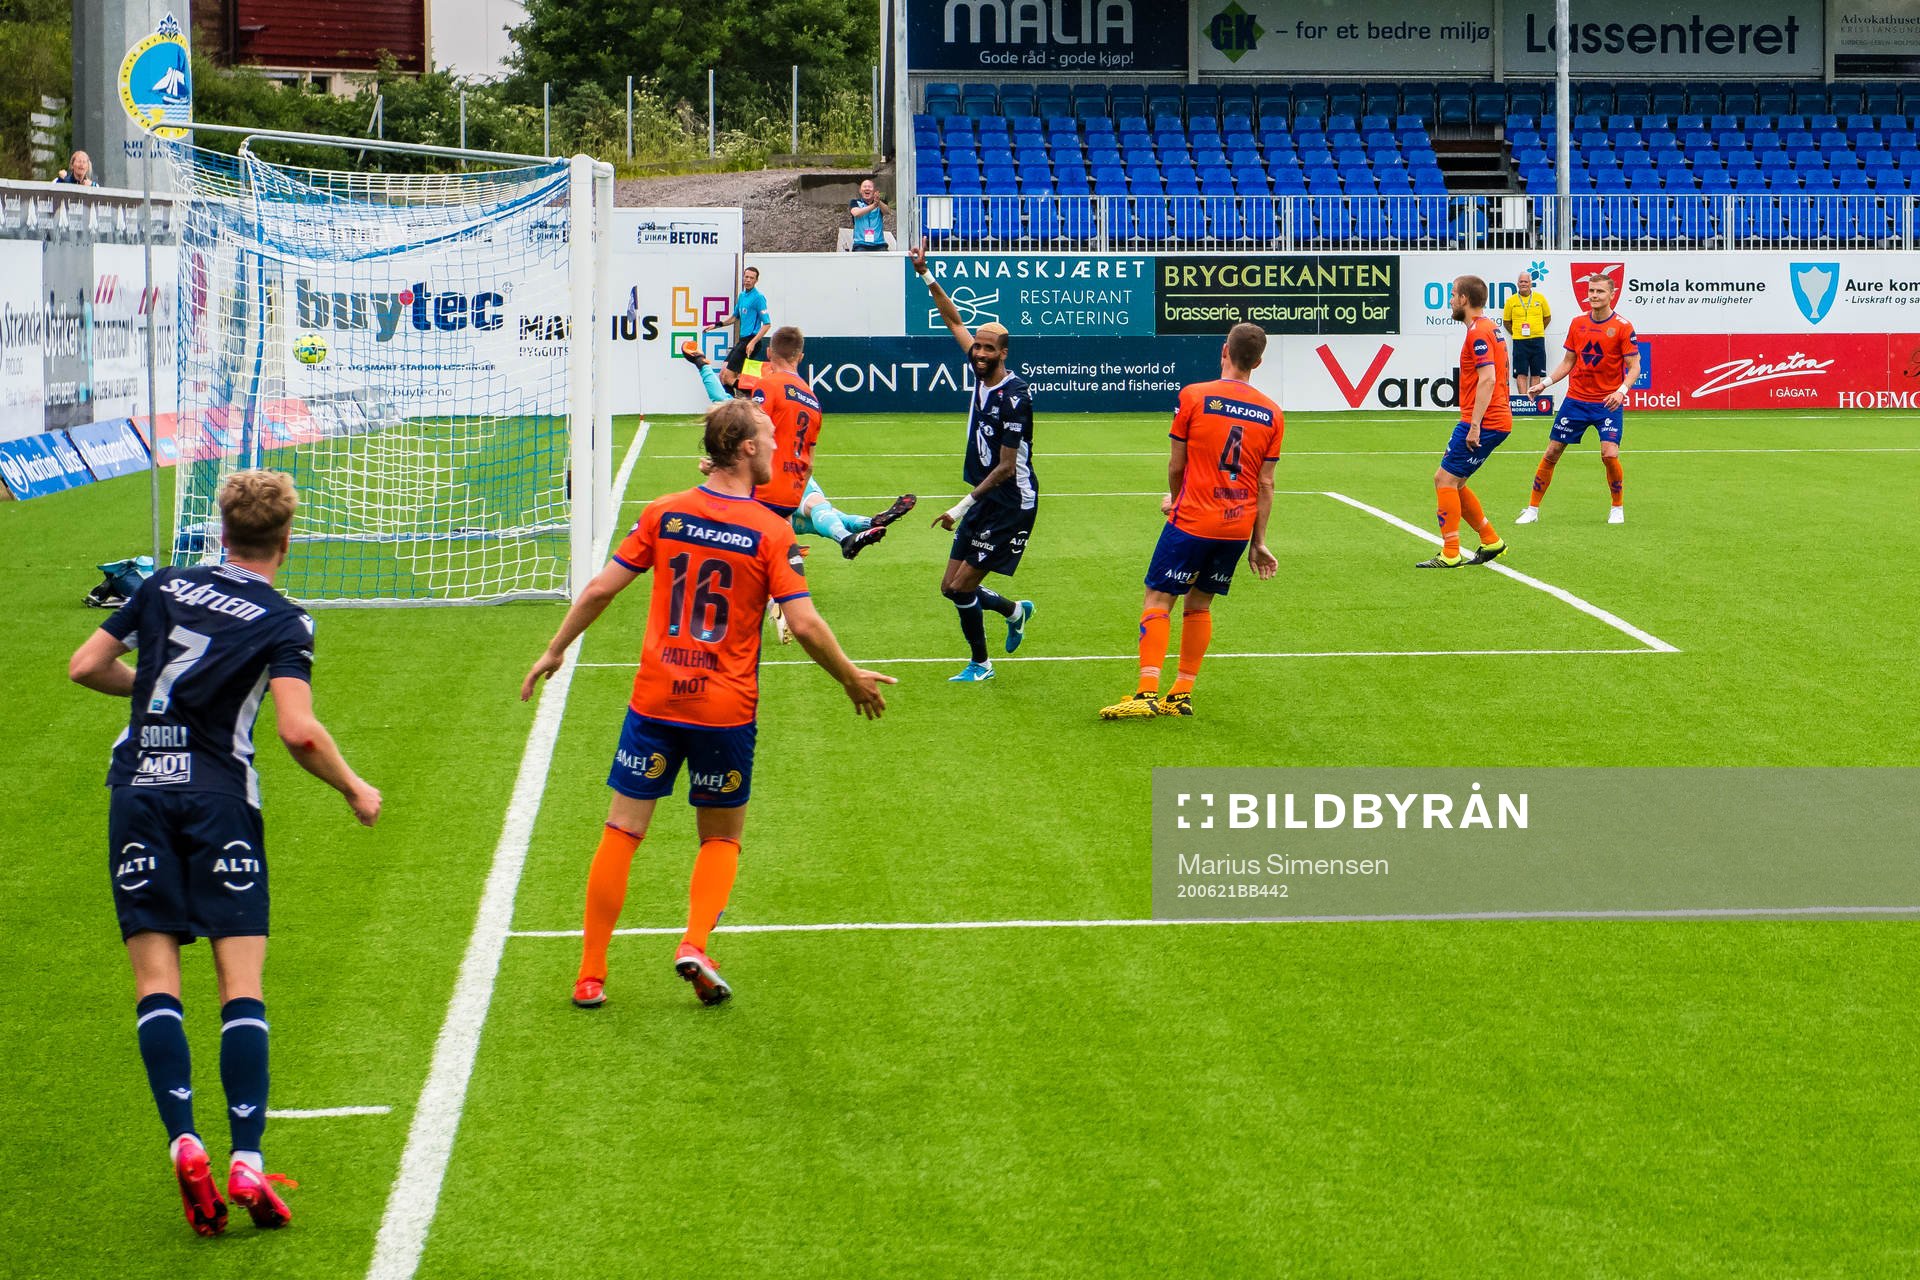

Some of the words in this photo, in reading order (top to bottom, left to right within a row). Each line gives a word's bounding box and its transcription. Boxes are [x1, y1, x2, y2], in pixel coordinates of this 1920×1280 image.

[944, 0, 1133, 44] MALIA
[1210, 13, 1258, 50] GK
[1296, 21, 1328, 39] for
[1336, 23, 1358, 40] et
[1368, 21, 1431, 40] bedre
[1440, 21, 1490, 43] miljø
[1526, 13, 1800, 55] Lassenteret
[979, 50, 1018, 64] Gode
[1022, 49, 1046, 64] råd
[1059, 51, 1096, 67] gode
[1100, 50, 1134, 67] kjøp!
[670, 231, 719, 244] BETONG
[1165, 265, 1390, 287] BRYGGEKANTEN
[1628, 279, 1679, 292] Smøla
[1685, 279, 1766, 292] kommune
[1845, 279, 1883, 291] Aure
[1020, 289, 1132, 304] RESTAURANT
[1635, 296, 1648, 305] Øy
[1650, 296, 1654, 304] i
[1656, 296, 1665, 304] et
[1668, 296, 1684, 304] hav
[1701, 296, 1753, 306] muligheter
[1852, 296, 1892, 304] Livskraft
[1895, 297, 1906, 305] og
[295, 279, 504, 342] buytec
[1020, 311, 1033, 325] &
[1041, 310, 1129, 325] CATERING
[1165, 302, 1242, 323] brasserie,
[1247, 304, 1329, 321] restaurant
[1334, 305, 1356, 324] og
[1362, 301, 1390, 321] bar
[4, 302, 41, 349] Stranda
[44, 302, 80, 375] Optiker
[808, 363, 976, 392] KONTAL
[1021, 362, 1097, 378] Systemizing
[1100, 362, 1121, 374] the
[1124, 363, 1159, 374] world
[1162, 362, 1175, 374] of
[1315, 343, 1460, 408] Vard
[1029, 380, 1099, 394] quaculture
[1101, 380, 1126, 391] and
[1128, 380, 1181, 391] fisheries
[1770, 389, 1773, 398] I
[1775, 386, 1818, 398] GÅGATA
[1635, 391, 1680, 407] Hotel
[1225, 404, 1270, 422] TAFJORD
[1218, 425, 1244, 479] 4
[685, 524, 753, 549] TAFJORD
[668, 552, 734, 643] 16
[147, 625, 211, 714] 7
[672, 676, 710, 695] MOT
[142, 754, 188, 775] MOT
[616, 749, 648, 771] AMFI
[116, 856, 155, 877] ALTI
[213, 858, 260, 873] ALTI
